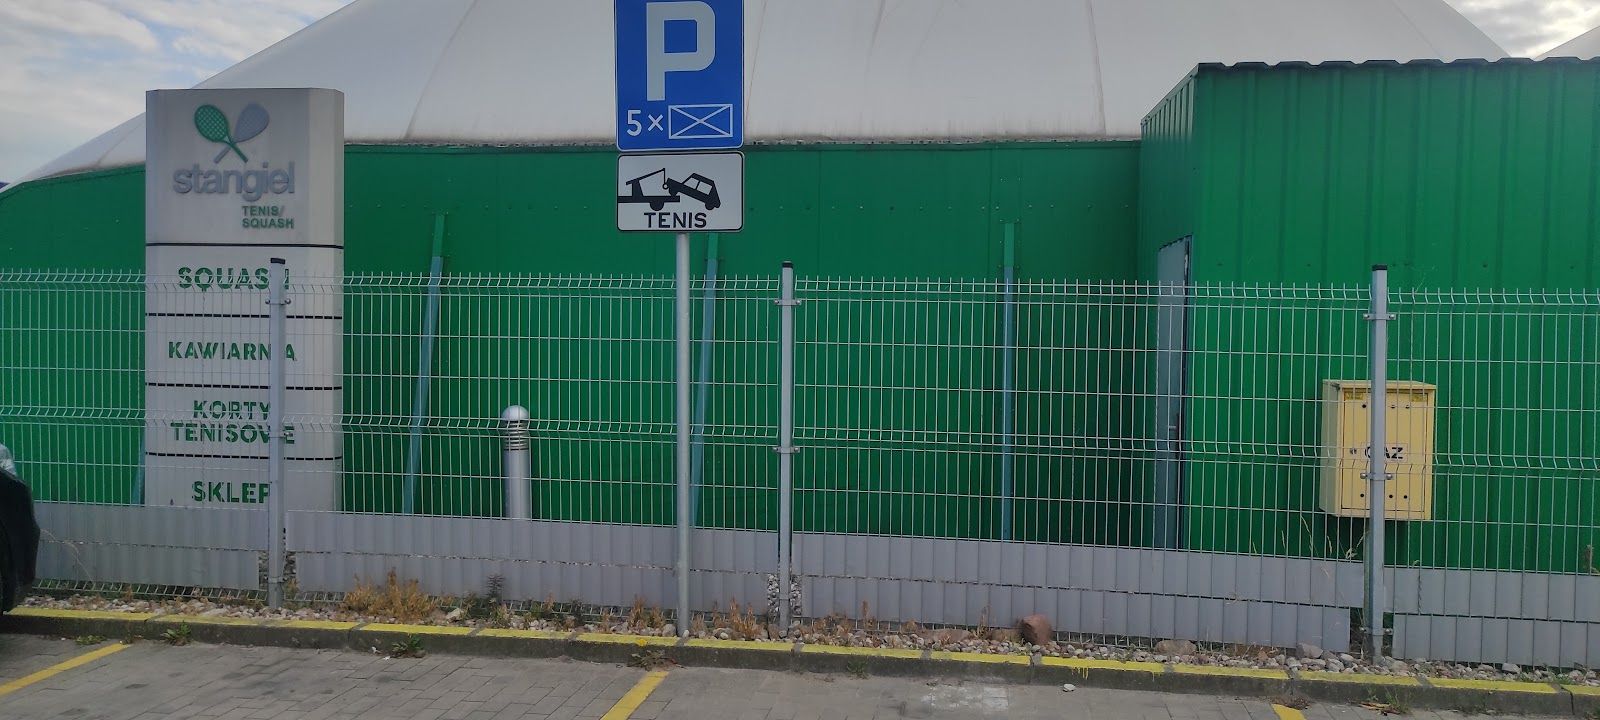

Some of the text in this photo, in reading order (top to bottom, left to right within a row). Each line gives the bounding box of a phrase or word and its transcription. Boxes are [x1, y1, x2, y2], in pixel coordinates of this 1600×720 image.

[646, 1, 715, 101] P
[173, 162, 295, 202] stangiel
[242, 205, 285, 216] TENIS/
[643, 212, 707, 228] TENIS
[242, 218, 294, 229] SQUASH
[178, 267, 289, 291] SQUAS
[168, 342, 296, 361] KAWIARNA
[193, 400, 271, 420] KORTY
